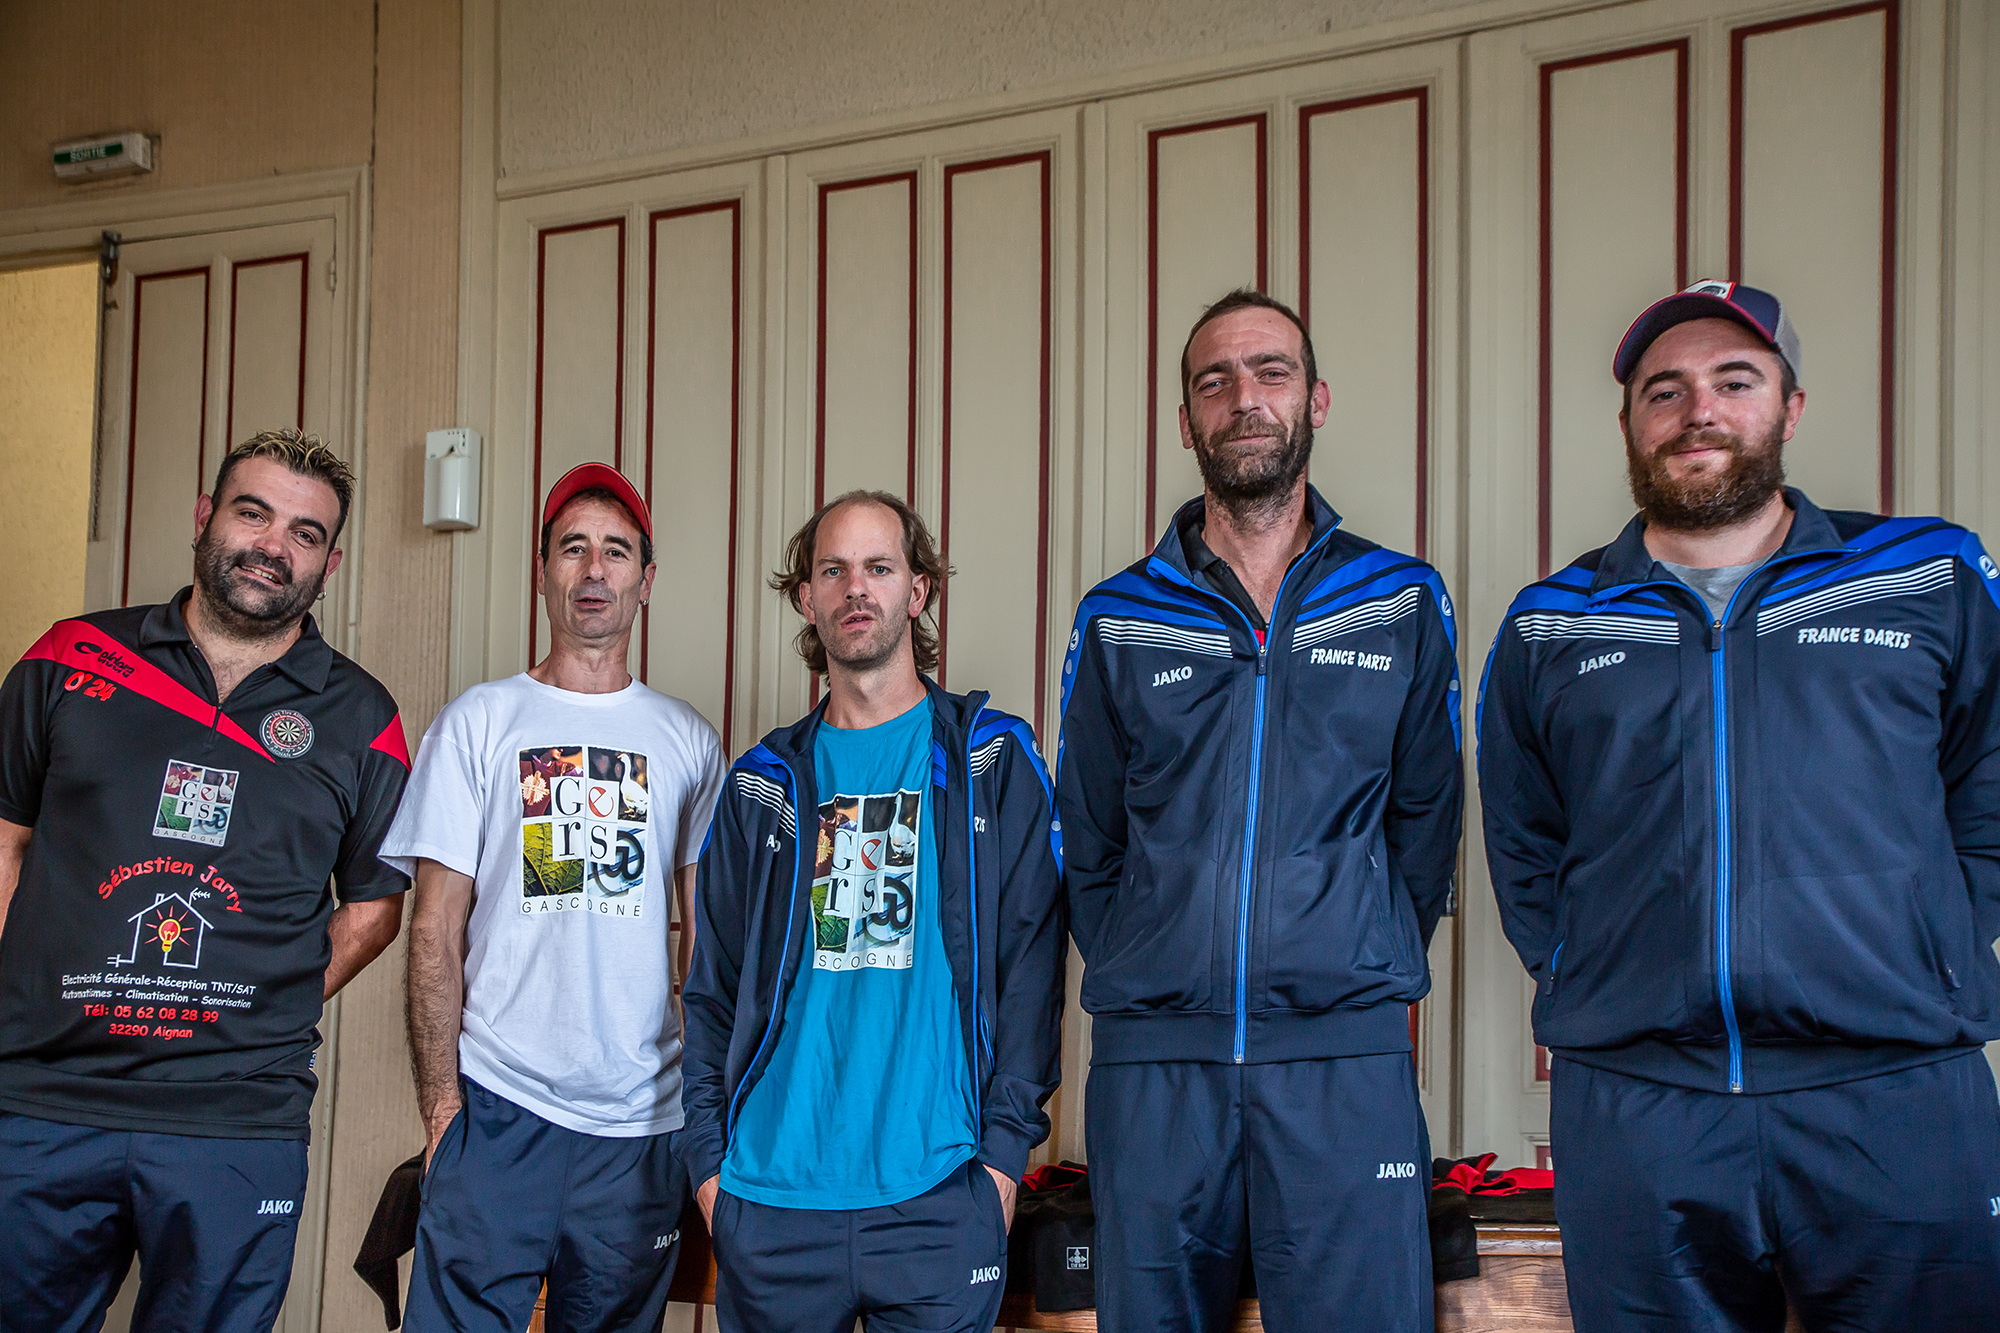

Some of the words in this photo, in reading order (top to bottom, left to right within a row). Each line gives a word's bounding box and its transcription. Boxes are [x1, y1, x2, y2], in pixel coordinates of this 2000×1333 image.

[1797, 627, 1861, 644] FRANCE
[1863, 628, 1912, 650] DARTS
[1310, 648, 1356, 666] FRANCE
[1357, 651, 1392, 672] DARTS
[1577, 651, 1627, 676] JAKO
[1152, 665, 1193, 687] JAKO
[154, 829, 225, 846] GASCOGNE
[98, 856, 194, 899] Sébastien
[199, 864, 243, 914] Jarry
[521, 897, 641, 917] GASCOGNE
[818, 952, 913, 970] SCOGNE
[210, 981, 257, 995] TNT/SAT
[125, 989, 189, 1004] Climatisation
[201, 995, 252, 1009] Sonorisation
[83, 1004, 110, 1017] Tél:
[113, 1005, 132, 1018] 05
[136, 1006, 155, 1019] 62
[158, 1007, 177, 1020] 08
[181, 1008, 198, 1021] 28
[202, 1010, 219, 1023] 99
[108, 1023, 149, 1037] 32290
[152, 1025, 193, 1041] Aignan
[1376, 1162, 1417, 1179] JAKO
[257, 1200, 295, 1215] JAKO
[970, 1265, 1001, 1285] JAKO
